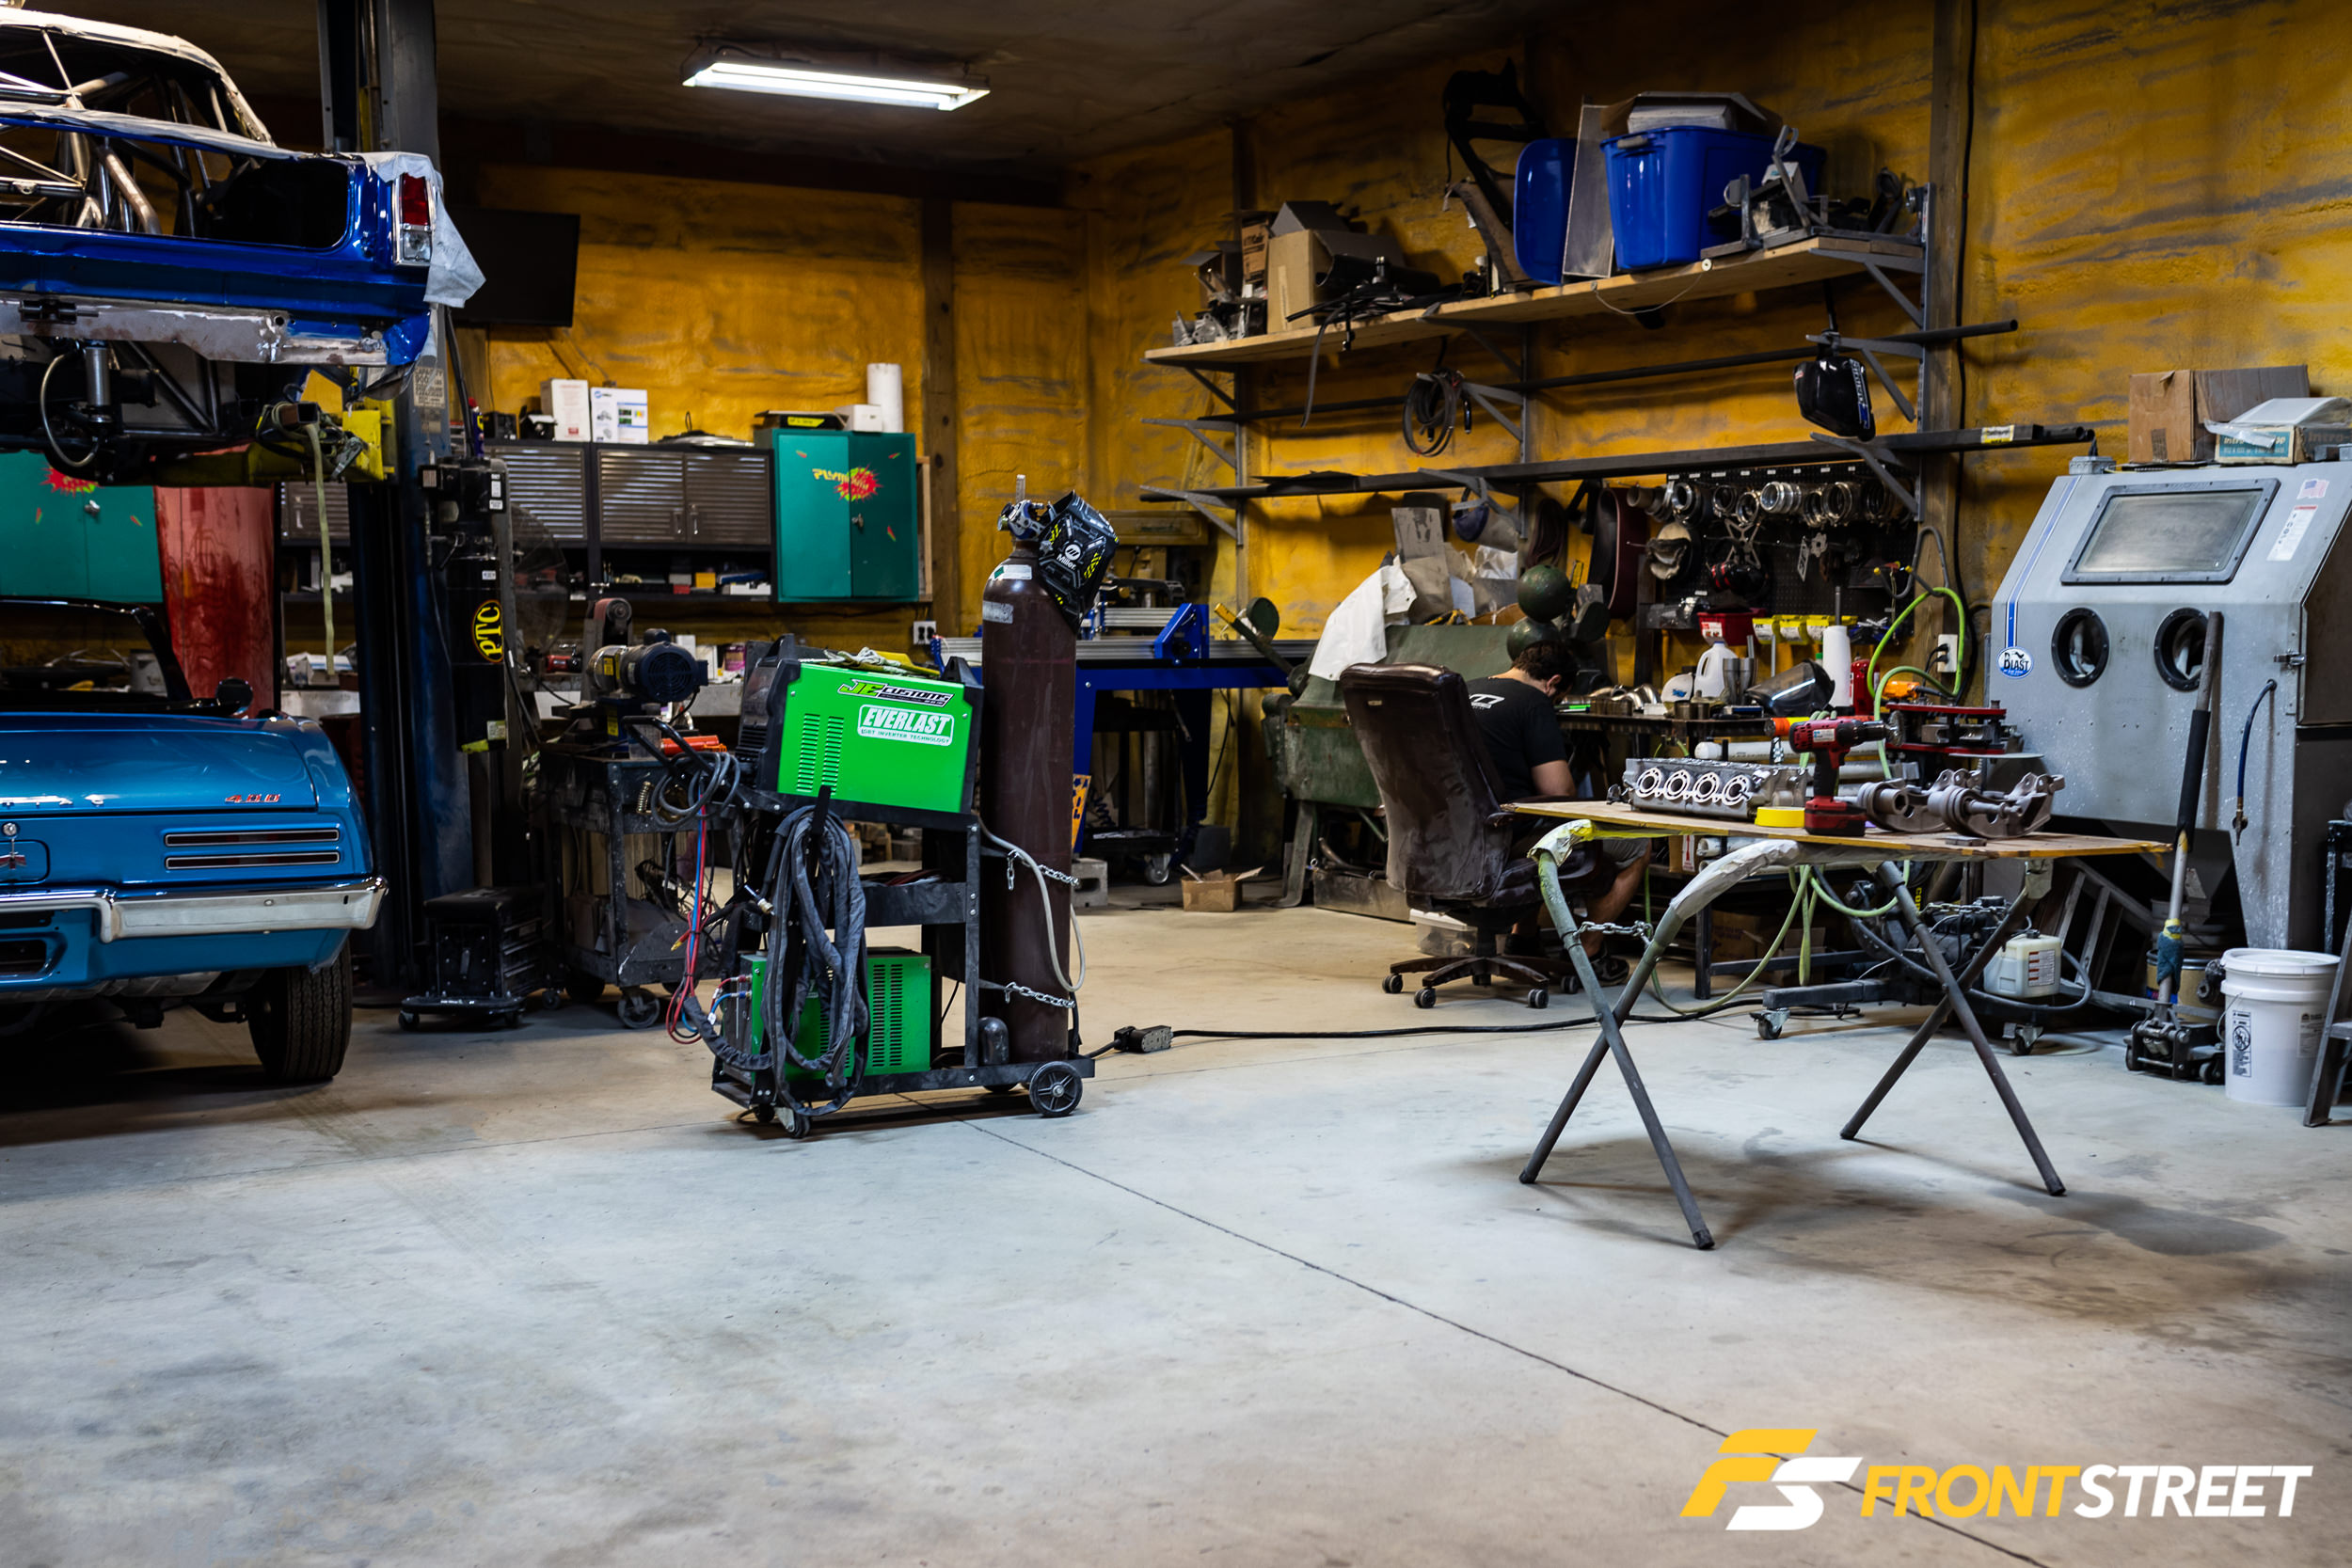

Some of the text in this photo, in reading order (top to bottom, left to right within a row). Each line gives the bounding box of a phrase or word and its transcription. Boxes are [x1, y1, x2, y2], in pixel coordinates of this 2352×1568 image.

[1057, 553, 1077, 571] Miller
[475, 606, 502, 657] PTC
[839, 681, 885, 696] JE
[882, 687, 950, 702] CUSTOMS
[863, 708, 951, 735] EVERLAST
[878, 731, 908, 739] INVERTER
[910, 735, 950, 744] TECHNOLOGY
[225, 794, 280, 803] 400
